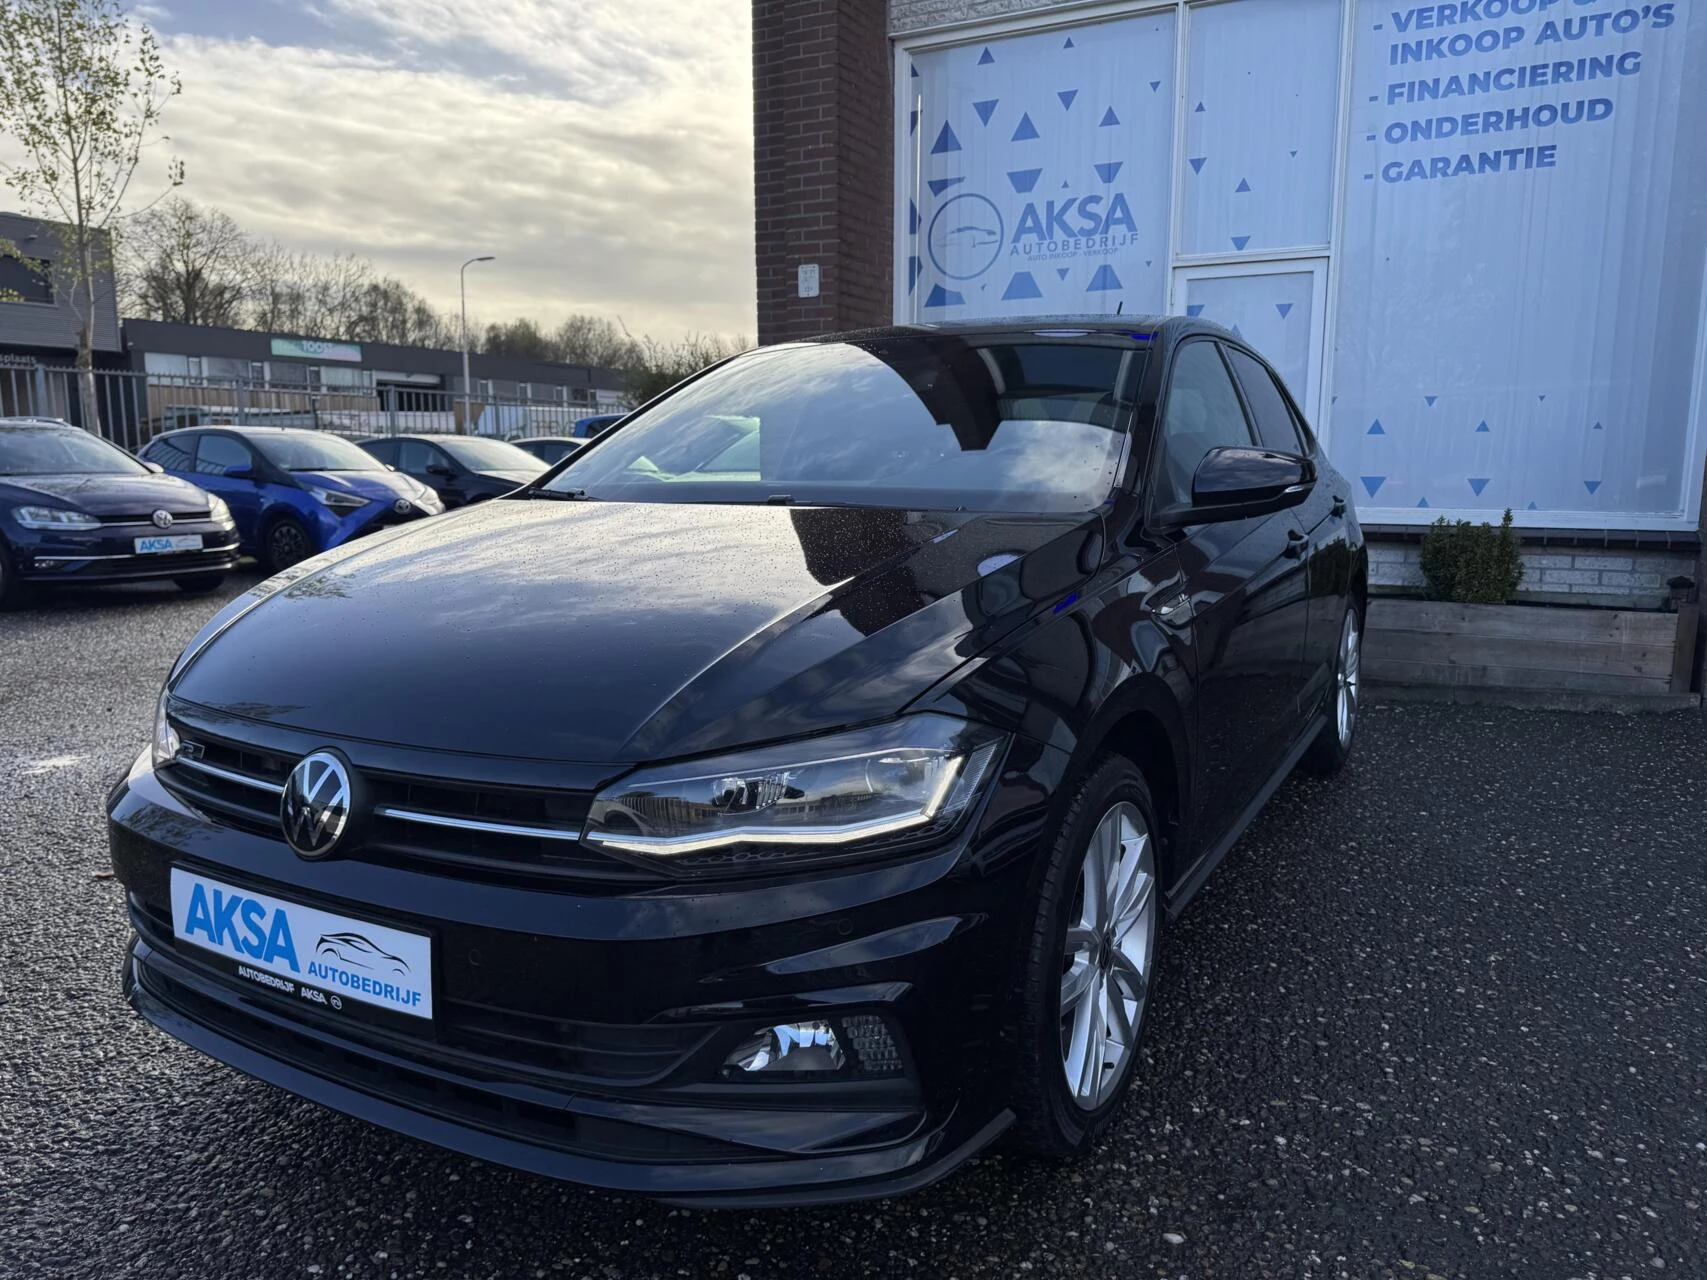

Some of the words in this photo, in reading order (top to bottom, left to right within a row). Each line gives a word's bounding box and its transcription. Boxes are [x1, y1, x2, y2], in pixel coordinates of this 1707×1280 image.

[1389, 26, 1525, 66] INKOOP
[1387, 51, 1643, 106] FINANCIERING
[1384, 98, 1614, 144] ONDERHOUD
[1381, 145, 1557, 184] GARANTIE
[1011, 192, 1138, 244] AKSA
[1010, 232, 1139, 256] AUTOBEDRIJF
[140, 540, 173, 551] AKSA
[184, 883, 300, 973] AKSA
[238, 965, 295, 993] AUTOBEDRIJF
[301, 986, 328, 1005] AKSA
[307, 961, 422, 1006] AUTOBEDRIJF
